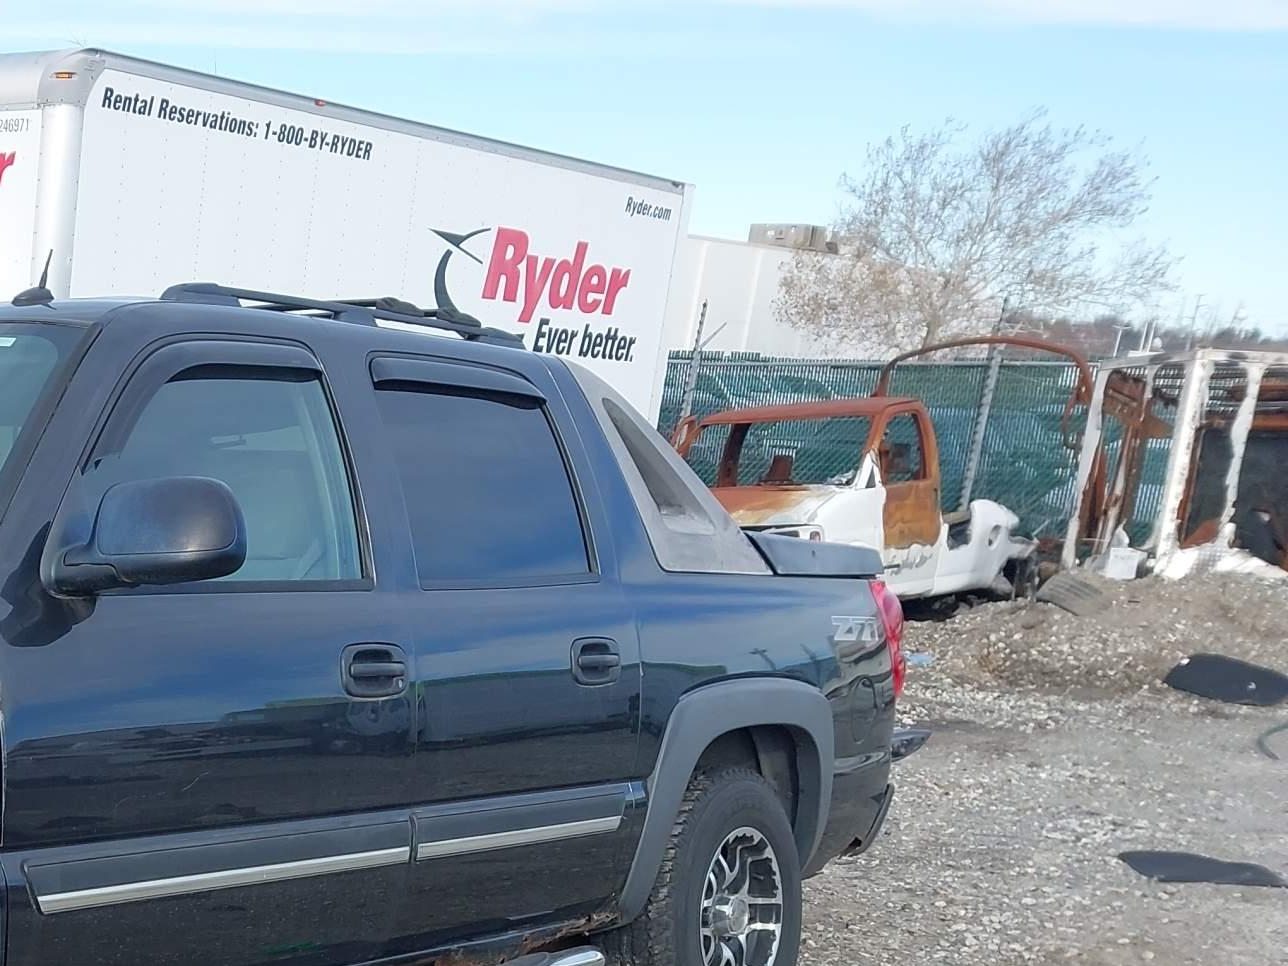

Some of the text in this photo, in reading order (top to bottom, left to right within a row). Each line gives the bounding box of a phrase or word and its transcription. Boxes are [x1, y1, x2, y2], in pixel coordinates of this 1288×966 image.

[101, 86, 374, 161] Rental Reservations: 1-800-BY-RYDER
[624, 196, 672, 221] Ryder.com
[481, 226, 632, 324] Ryder
[532, 317, 638, 363] Ever better.
